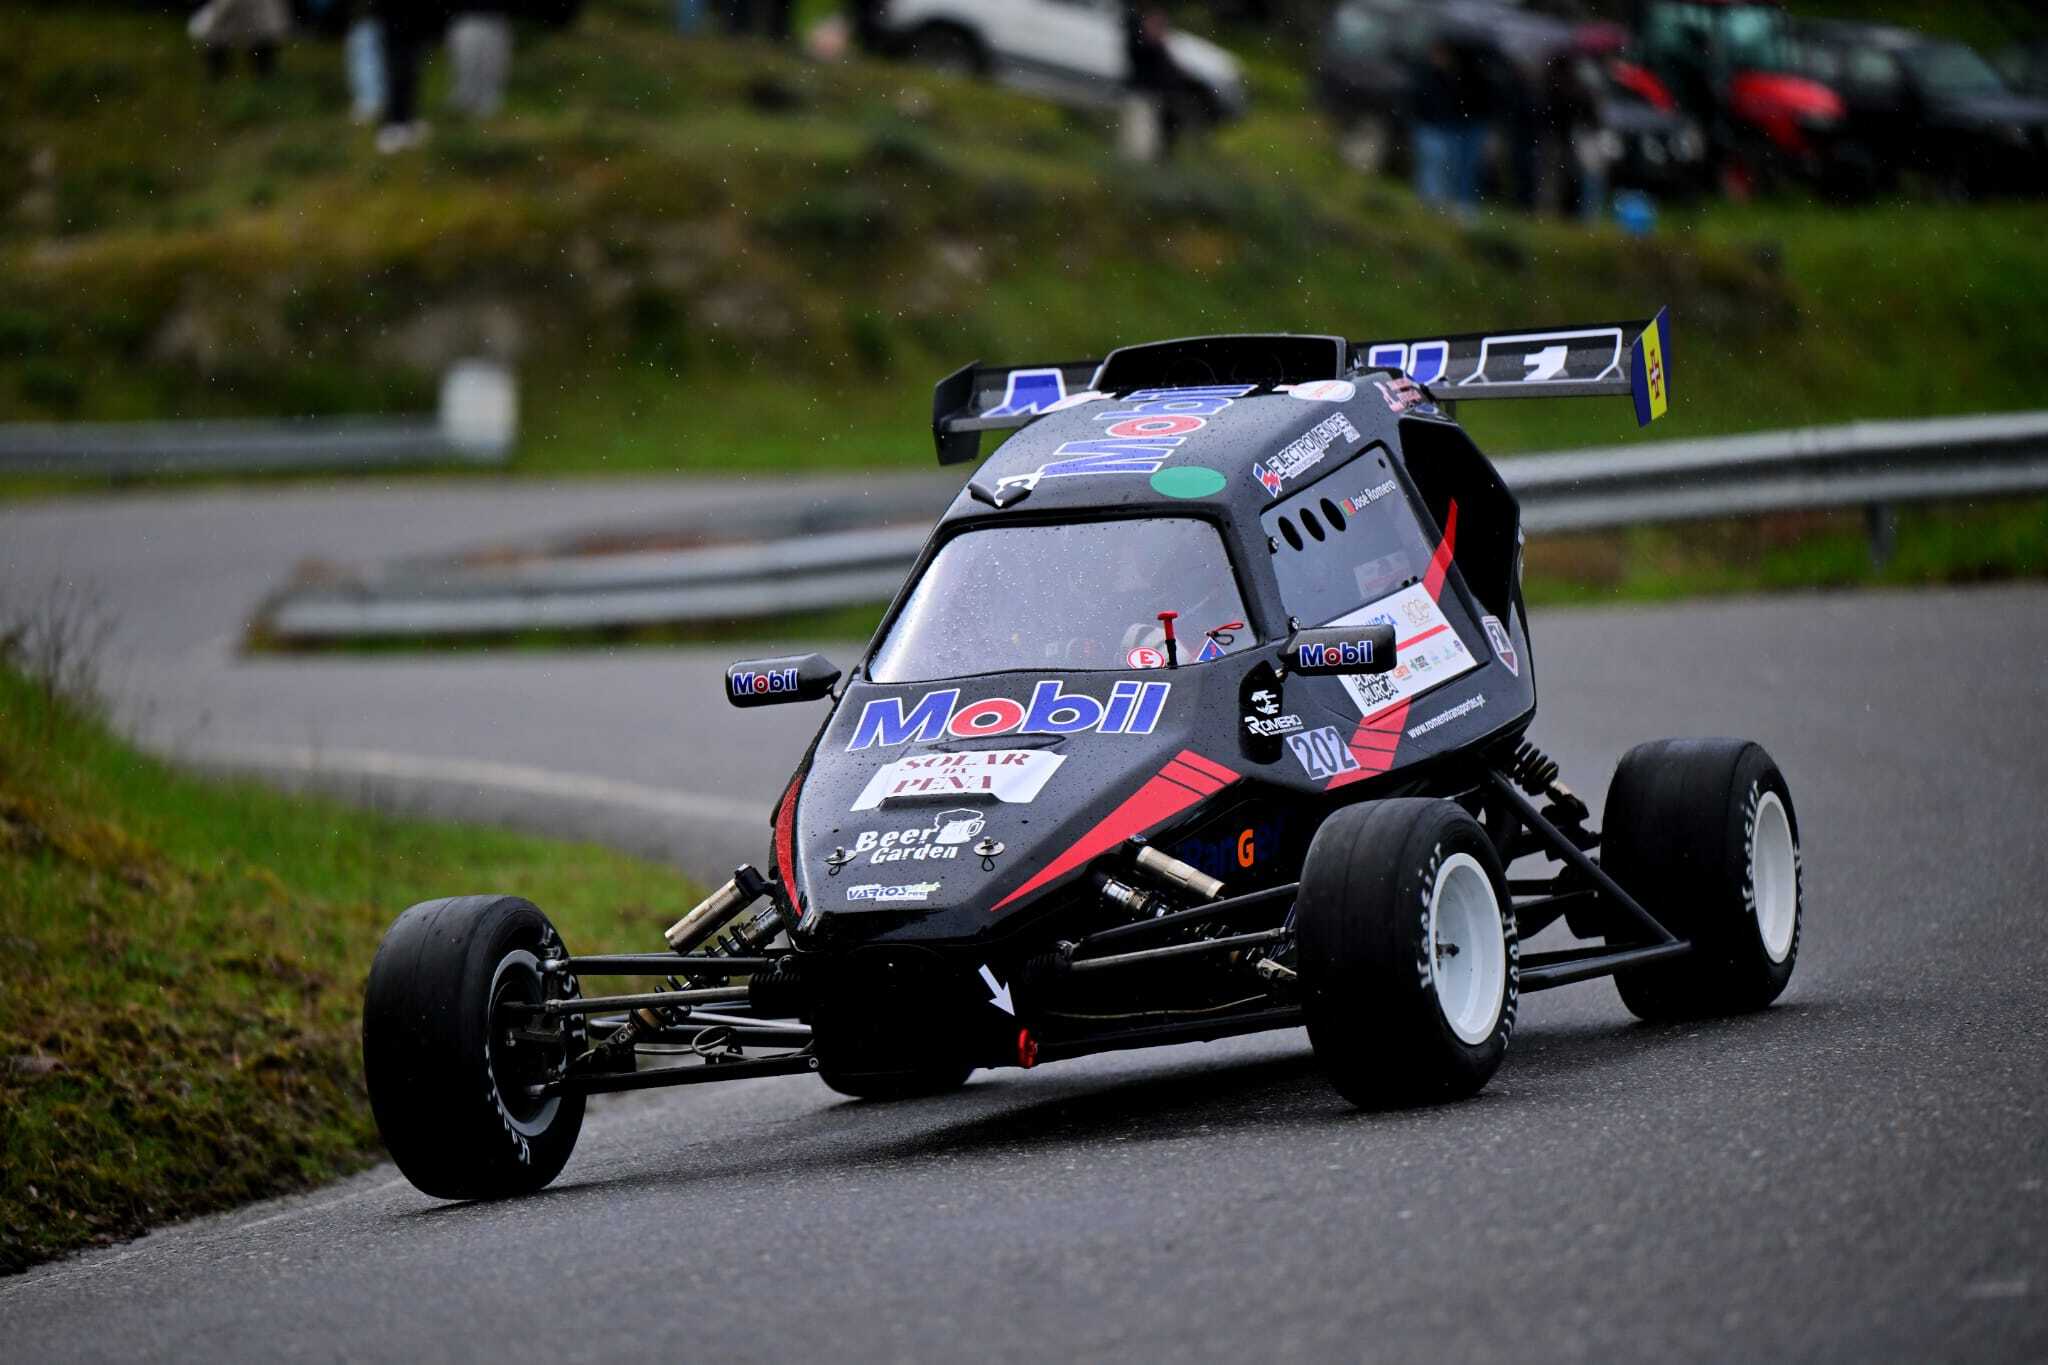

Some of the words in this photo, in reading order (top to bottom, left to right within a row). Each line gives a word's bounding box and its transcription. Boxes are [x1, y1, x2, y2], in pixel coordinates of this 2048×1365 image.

[1366, 480, 1396, 502] Romero
[1140, 651, 1154, 664] E
[1300, 640, 1373, 667] Mobil
[732, 668, 798, 695] Mobil
[846, 681, 1170, 751] Mobil
[905, 753, 1031, 769] SOLAR
[1292, 727, 1357, 777] 202
[856, 828, 935, 852] Beer
[870, 843, 959, 864] Garden
